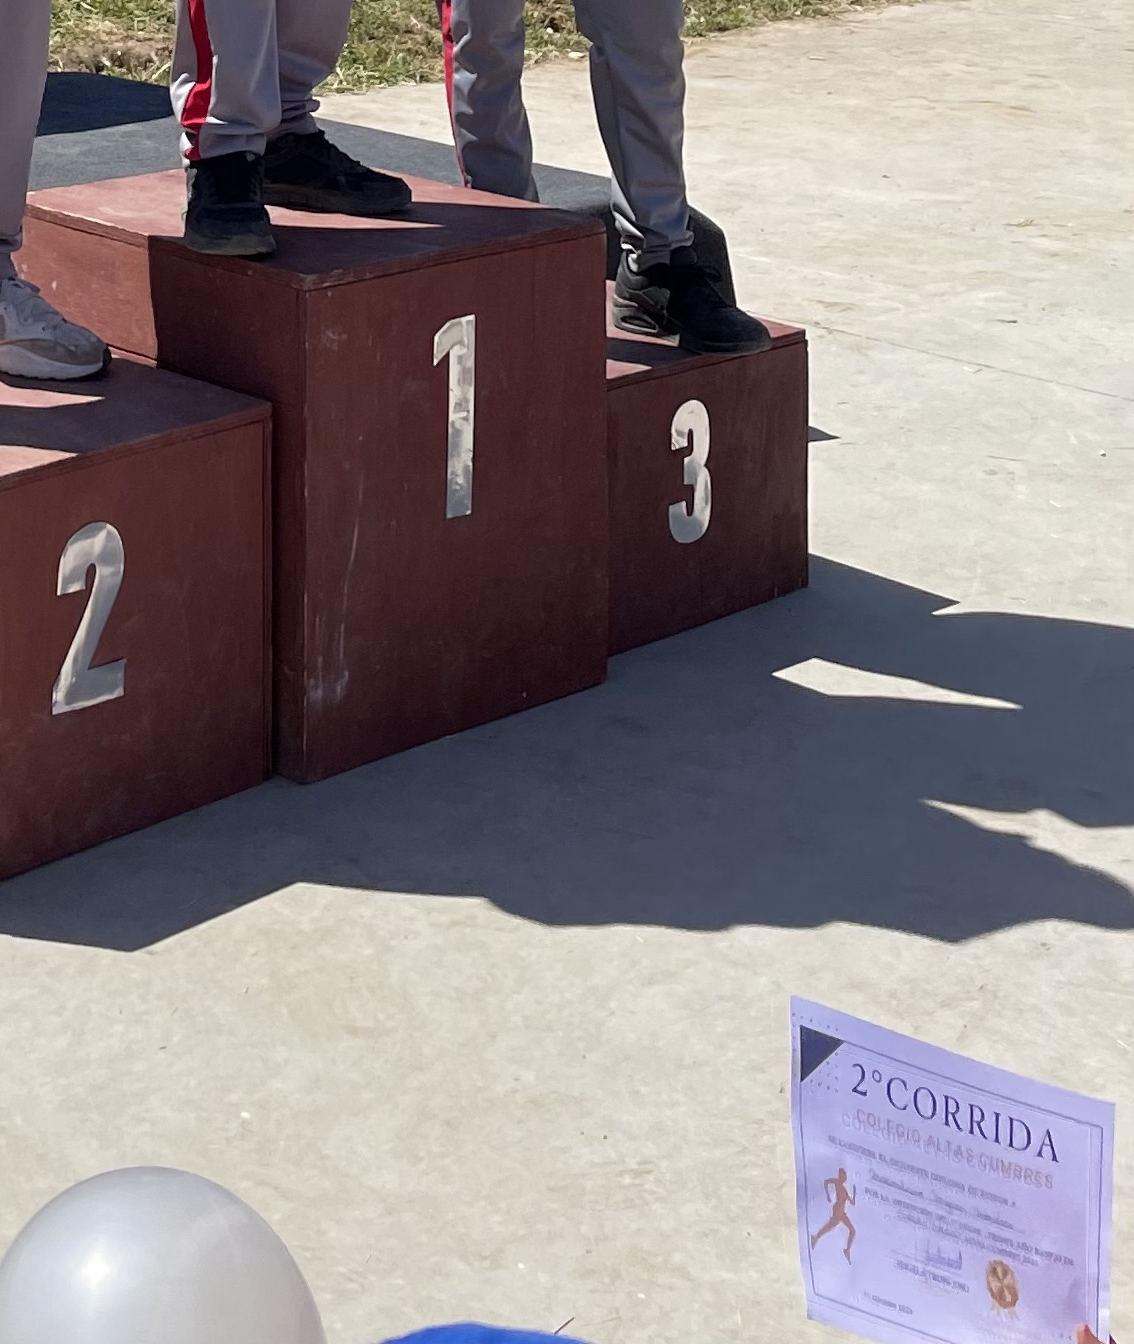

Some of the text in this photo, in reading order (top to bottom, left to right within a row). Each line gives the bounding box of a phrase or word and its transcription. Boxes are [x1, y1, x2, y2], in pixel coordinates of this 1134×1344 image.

[433, 314, 476, 519] 1
[669, 400, 712, 543] 3
[52, 521, 126, 715] 2
[851, 1063, 1060, 1163] 2°CORRIDA
